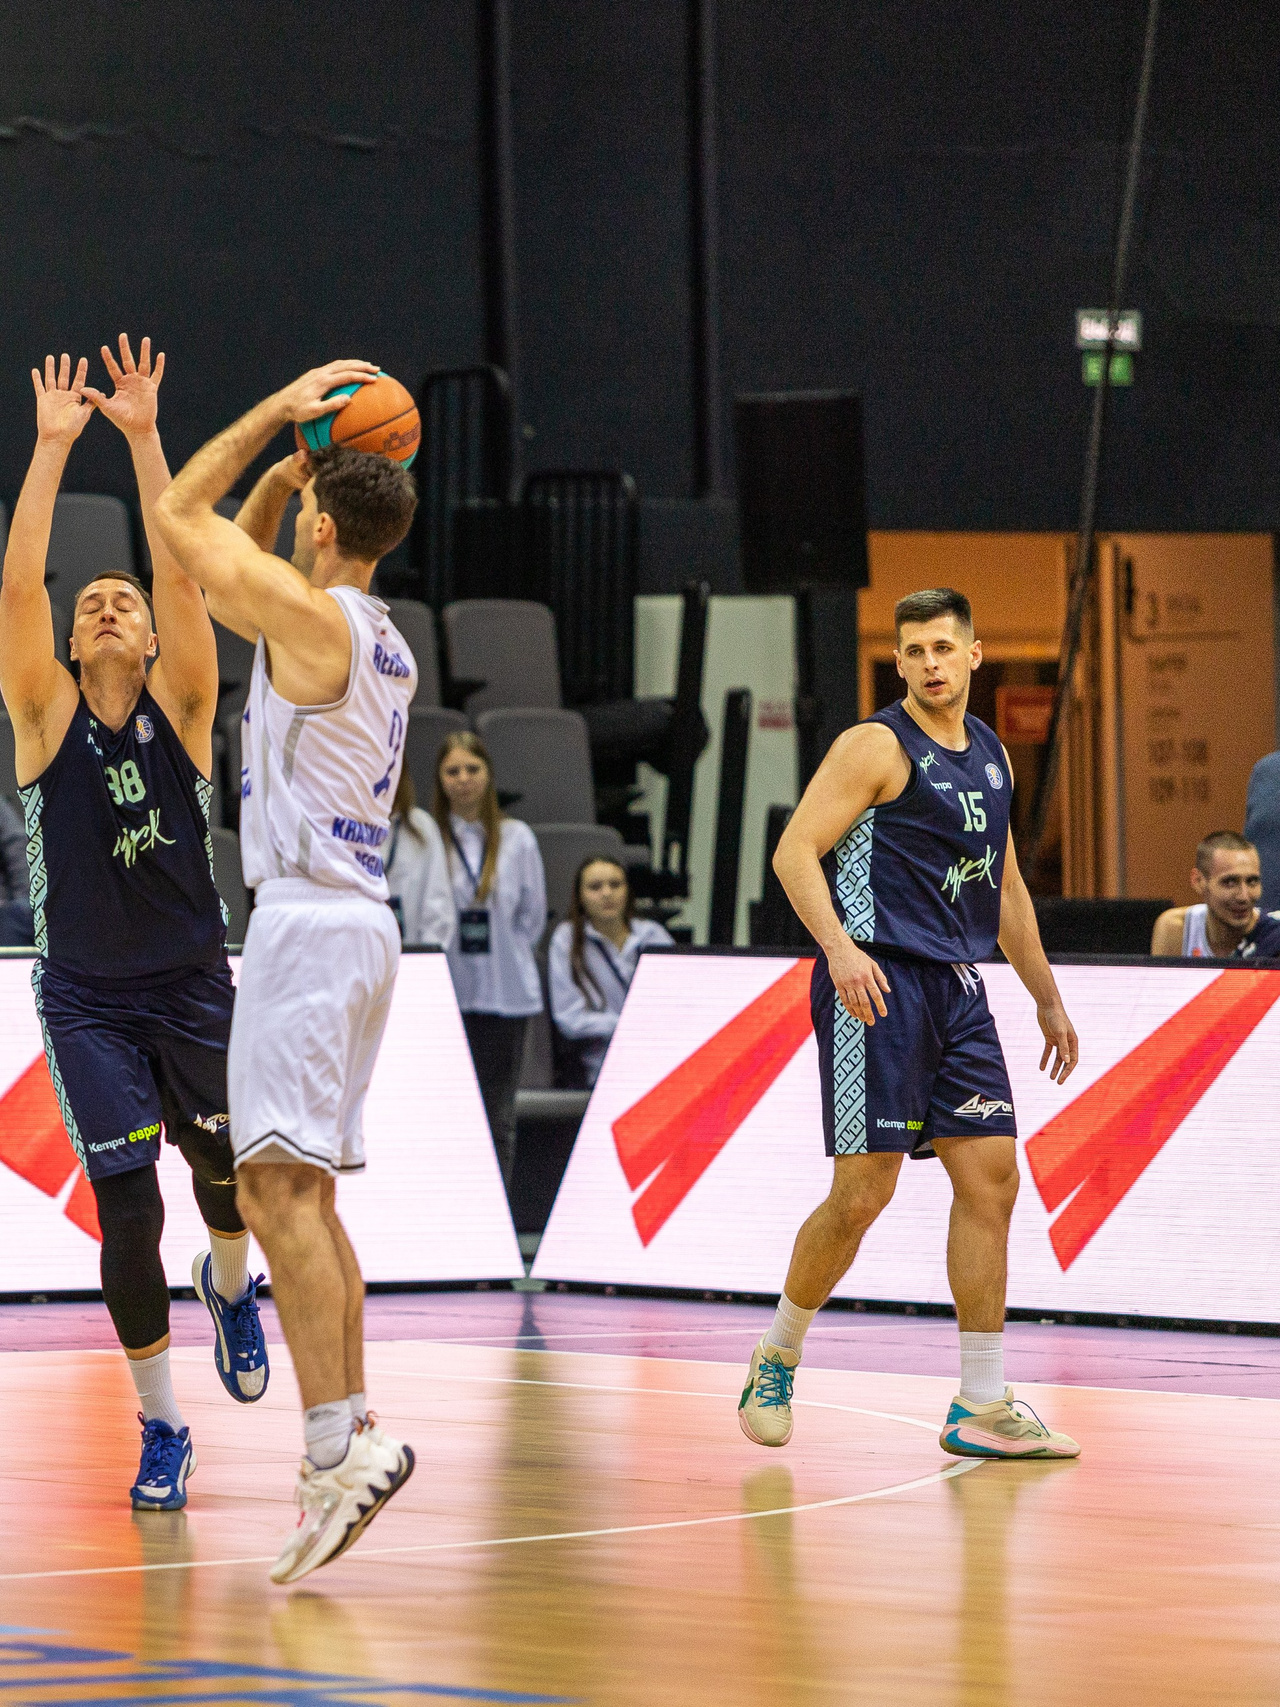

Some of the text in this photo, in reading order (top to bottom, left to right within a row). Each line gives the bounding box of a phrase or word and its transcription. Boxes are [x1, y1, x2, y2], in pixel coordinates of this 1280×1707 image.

[957, 791, 988, 832] 15
[876, 1118, 906, 1131] Kempa
[88, 1136, 126, 1154] Kempa
